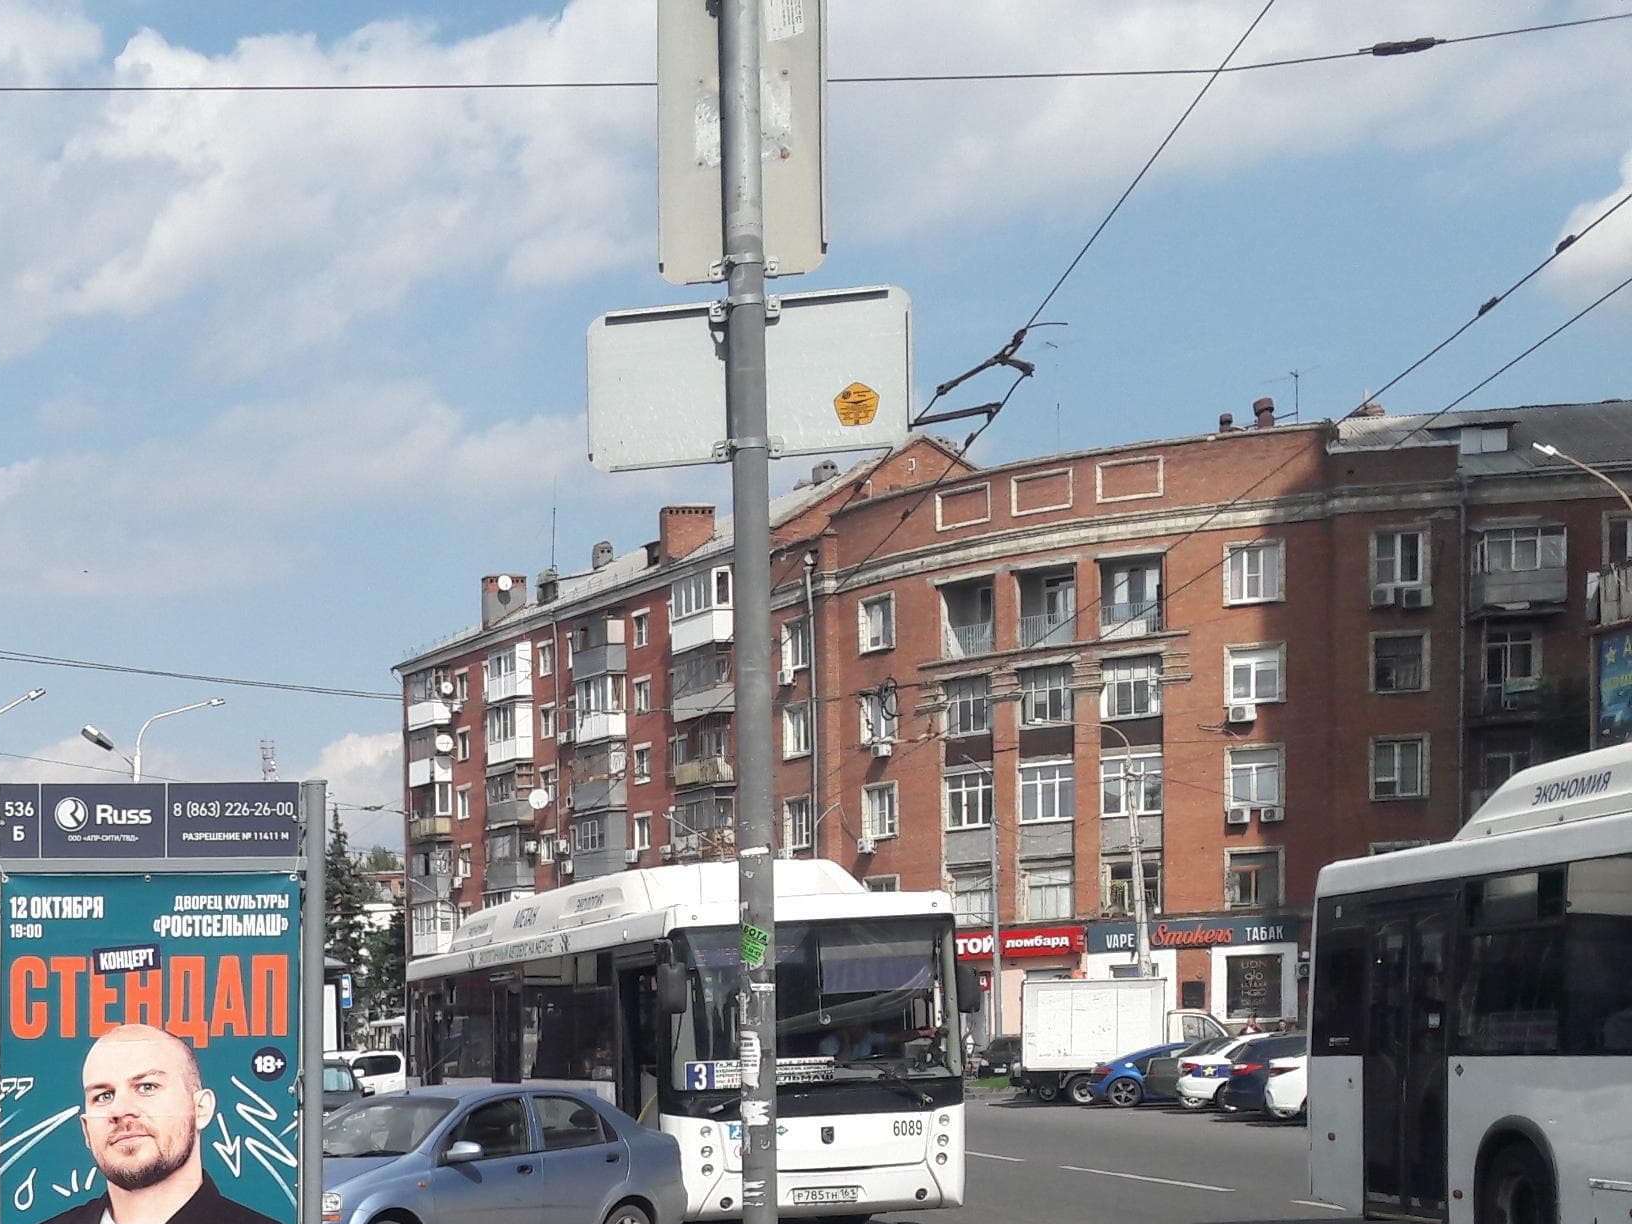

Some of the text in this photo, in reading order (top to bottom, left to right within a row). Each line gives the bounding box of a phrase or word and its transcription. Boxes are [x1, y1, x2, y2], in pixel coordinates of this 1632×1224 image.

[1532, 771, 1612, 806] ЭКОНОМИЯ
[4, 802, 35, 818] 536
[95, 804, 153, 825] Russ
[173, 801, 293, 819] 8 (863) 226-26-00
[12, 825, 25, 842] Б
[182, 831, 240, 842] РАЗРЕШЕНИЕ
[9, 896, 104, 919] 12 ОКТЯБРЯ
[173, 893, 289, 913] ДВОРЕЦ КУЛЬТУРЫ
[9, 923, 42, 939] 19:00
[153, 914, 289, 938] «РОСТСЕЛЬМАШ»
[1005, 935, 1070, 949] ломбард
[1106, 923, 1284, 950] VAPE Smokers ТАБАК
[99, 948, 155, 971] КОНЦЕРТ
[9, 954, 289, 1048] СТЕНДАП
[254, 1055, 285, 1074] 18+
[694, 1064, 707, 1090] 3
[893, 1120, 923, 1137] 6089
[797, 1190, 838, 1201] Р785ТН
